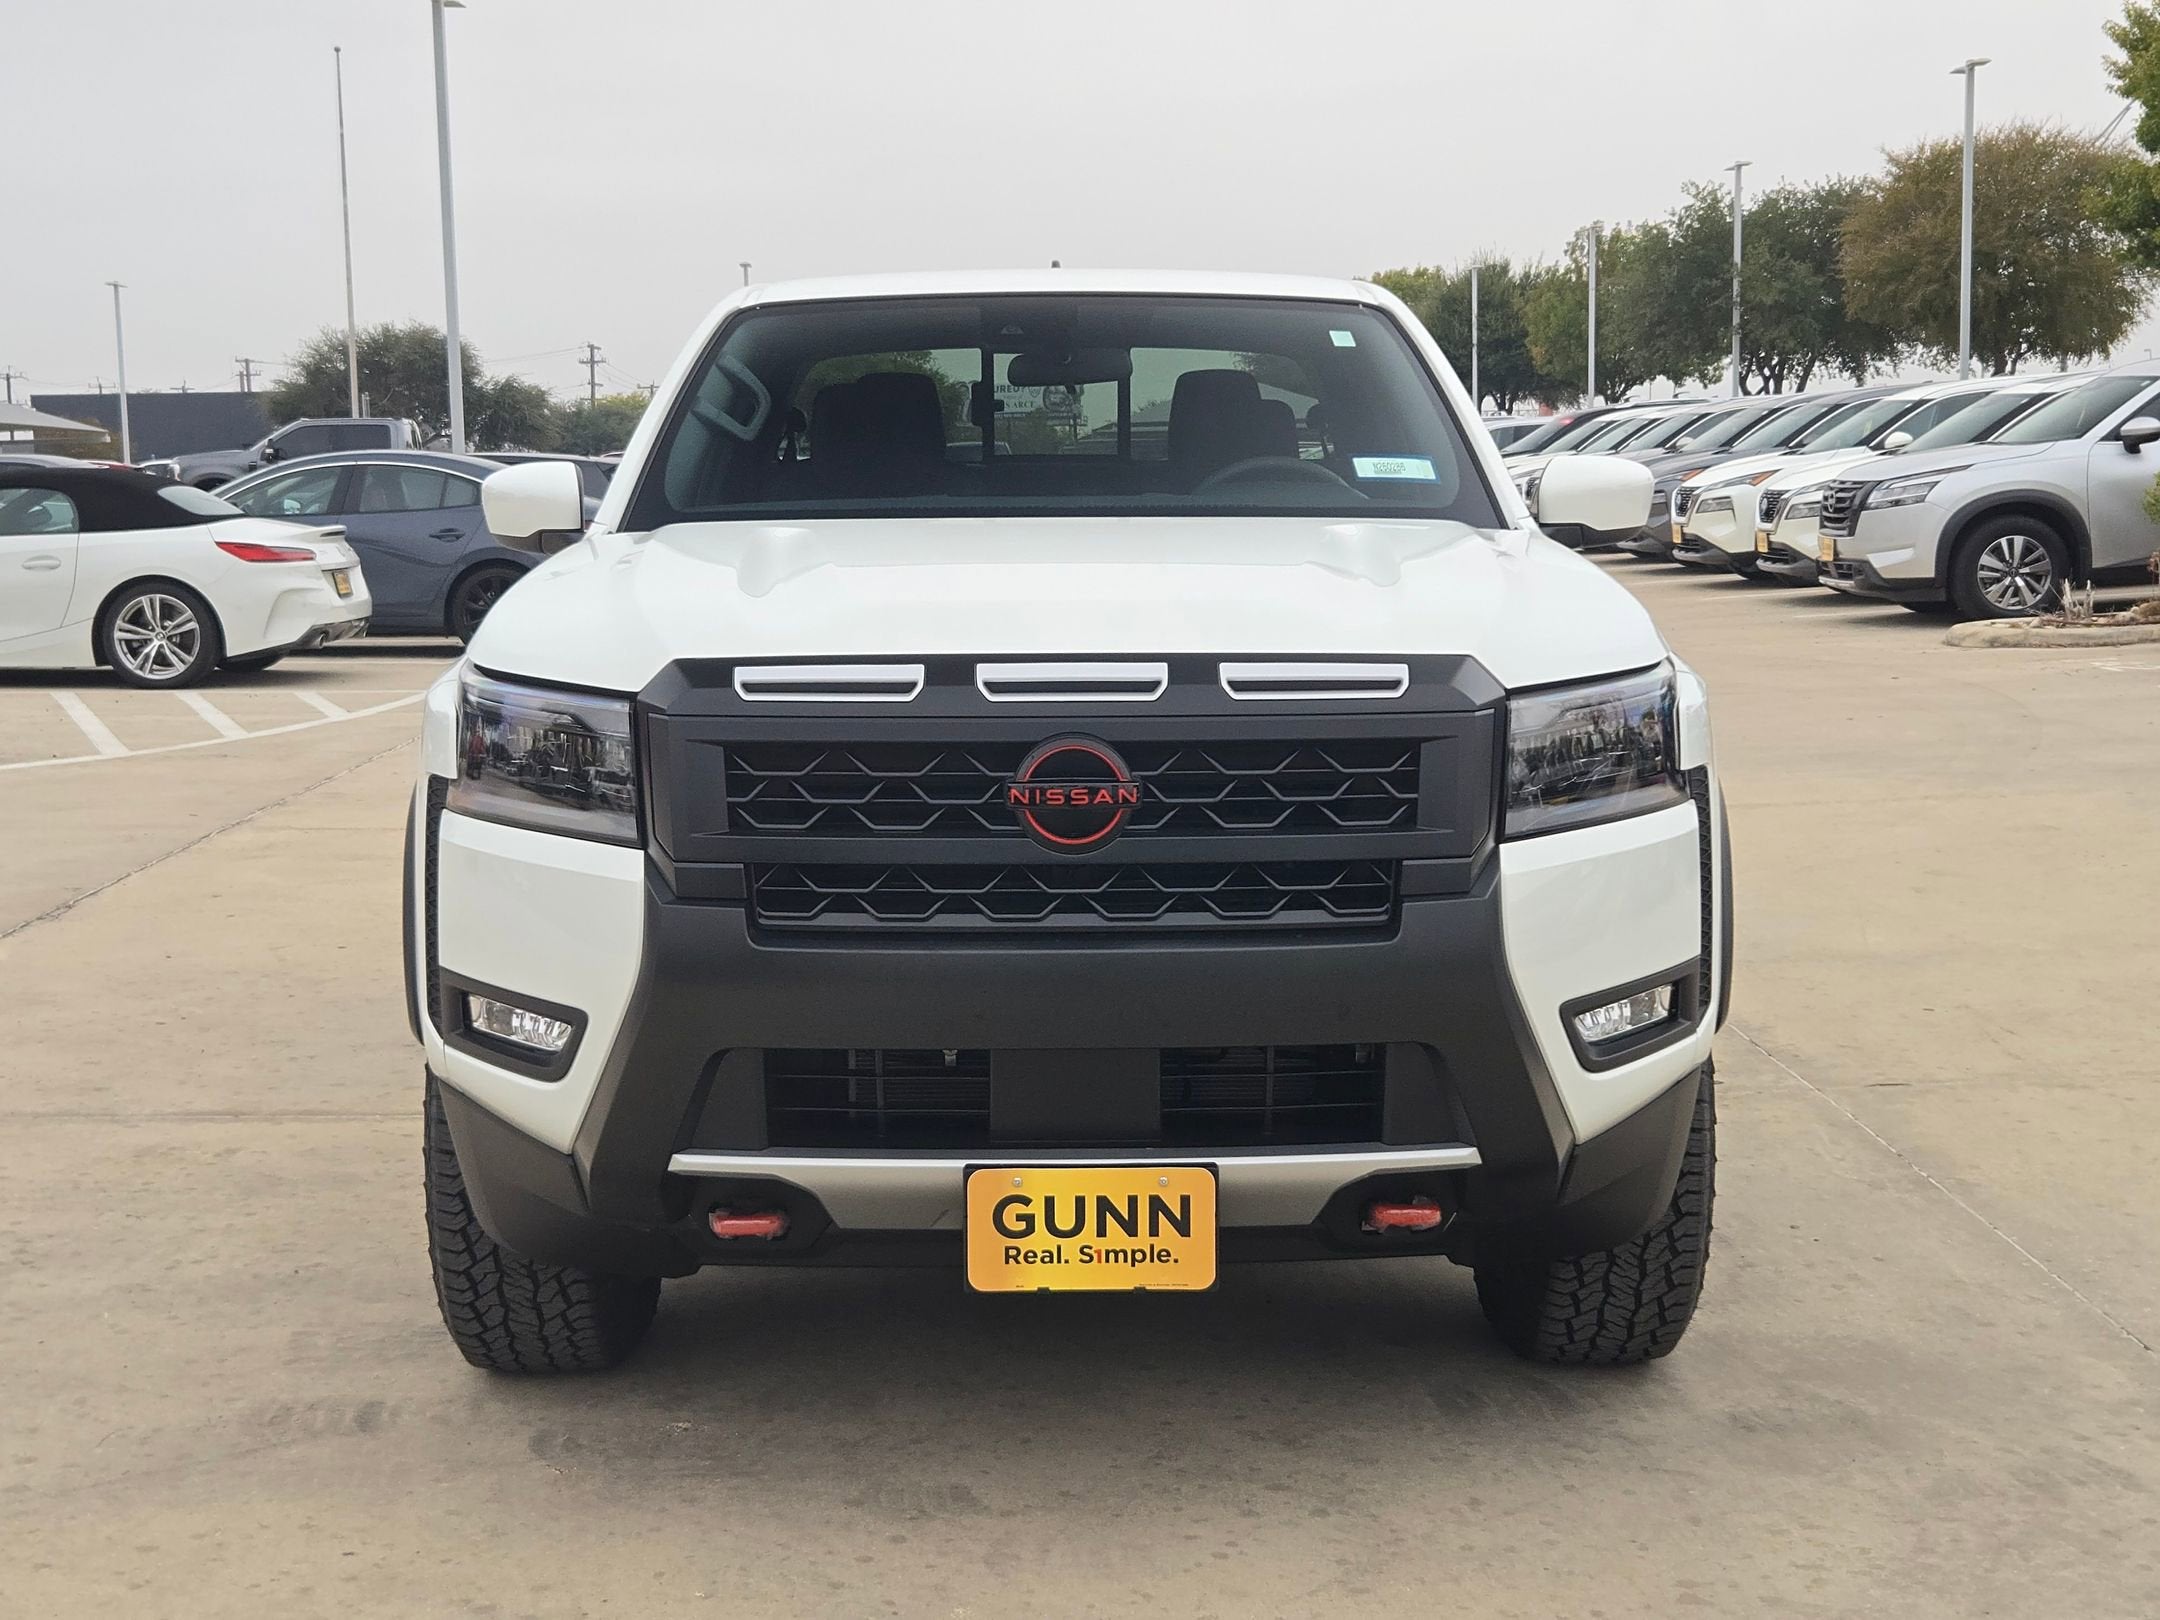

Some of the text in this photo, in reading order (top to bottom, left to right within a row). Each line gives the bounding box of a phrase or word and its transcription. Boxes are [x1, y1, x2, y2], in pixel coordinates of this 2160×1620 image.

[1009, 788, 1138, 805] NISSAN
[992, 1194, 1191, 1239] GUNN
[1004, 1245, 1070, 1265] Real.
